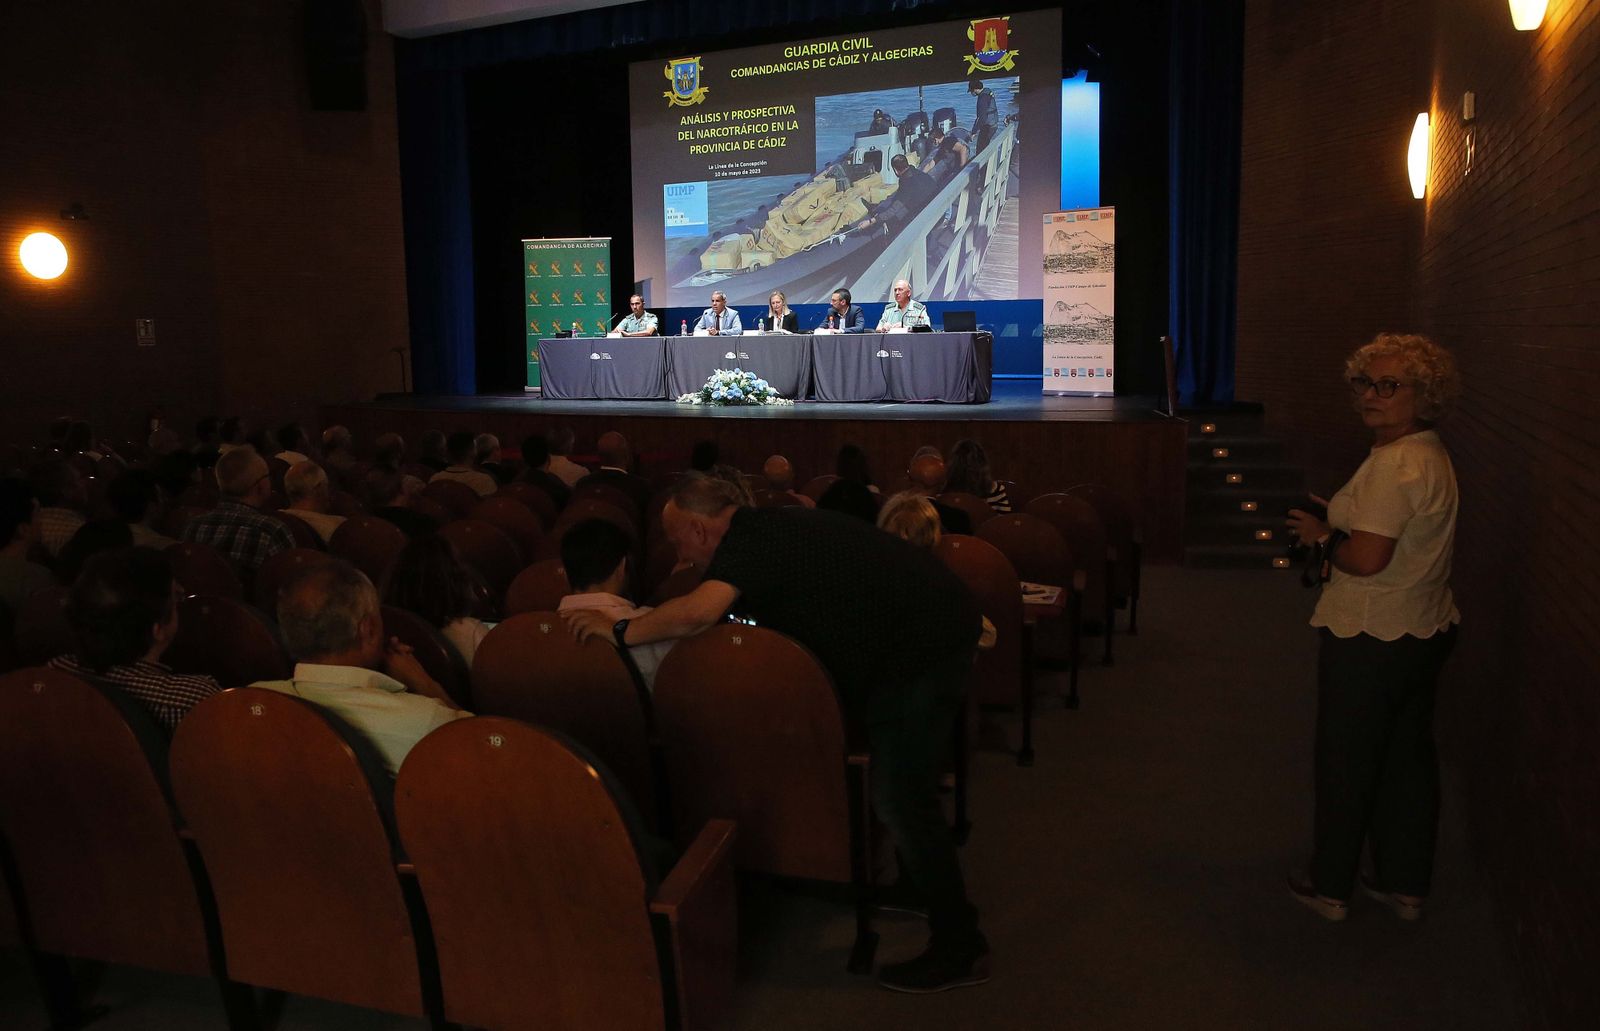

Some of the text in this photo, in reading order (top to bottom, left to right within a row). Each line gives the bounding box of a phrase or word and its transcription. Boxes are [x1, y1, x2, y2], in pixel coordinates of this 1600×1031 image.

[784, 37, 873, 58] GUARDIA CIVIL
[730, 45, 933, 78] COMANDANCIAS DE CÁDIZ Y ALGECIRAS
[680, 104, 796, 126] ANÁLISIS Y PROSPECTIVA
[678, 120, 799, 141] DEL NARCOTRÁFICO EN LA
[690, 136, 786, 155] PROVINCIA DE CÁDIZ
[667, 185, 695, 197] UIMP
[732, 636, 742, 645] 19
[251, 705, 262, 716] 18
[489, 735, 502, 746] 19
